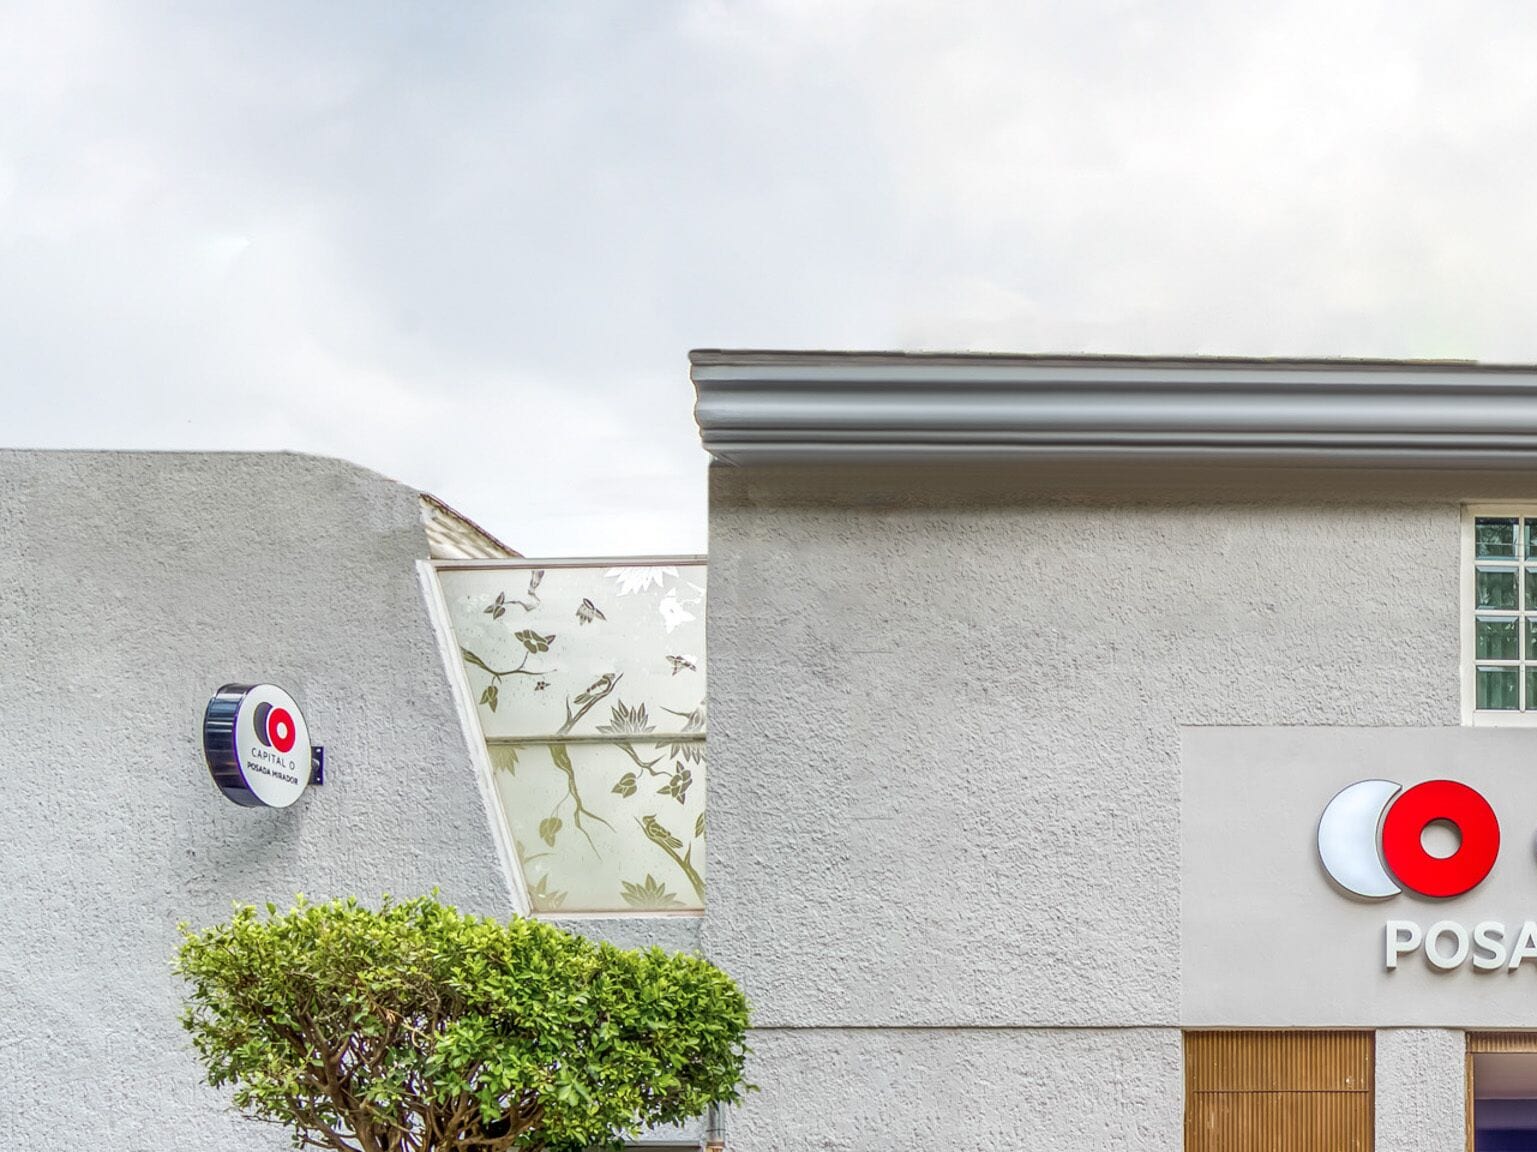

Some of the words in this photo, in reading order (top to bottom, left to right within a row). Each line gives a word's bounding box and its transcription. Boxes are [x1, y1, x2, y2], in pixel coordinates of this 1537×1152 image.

[251, 747, 286, 768] CAPITAL
[289, 761, 296, 770] O
[247, 761, 271, 775] POSADA
[272, 770, 298, 784] MIRADOR
